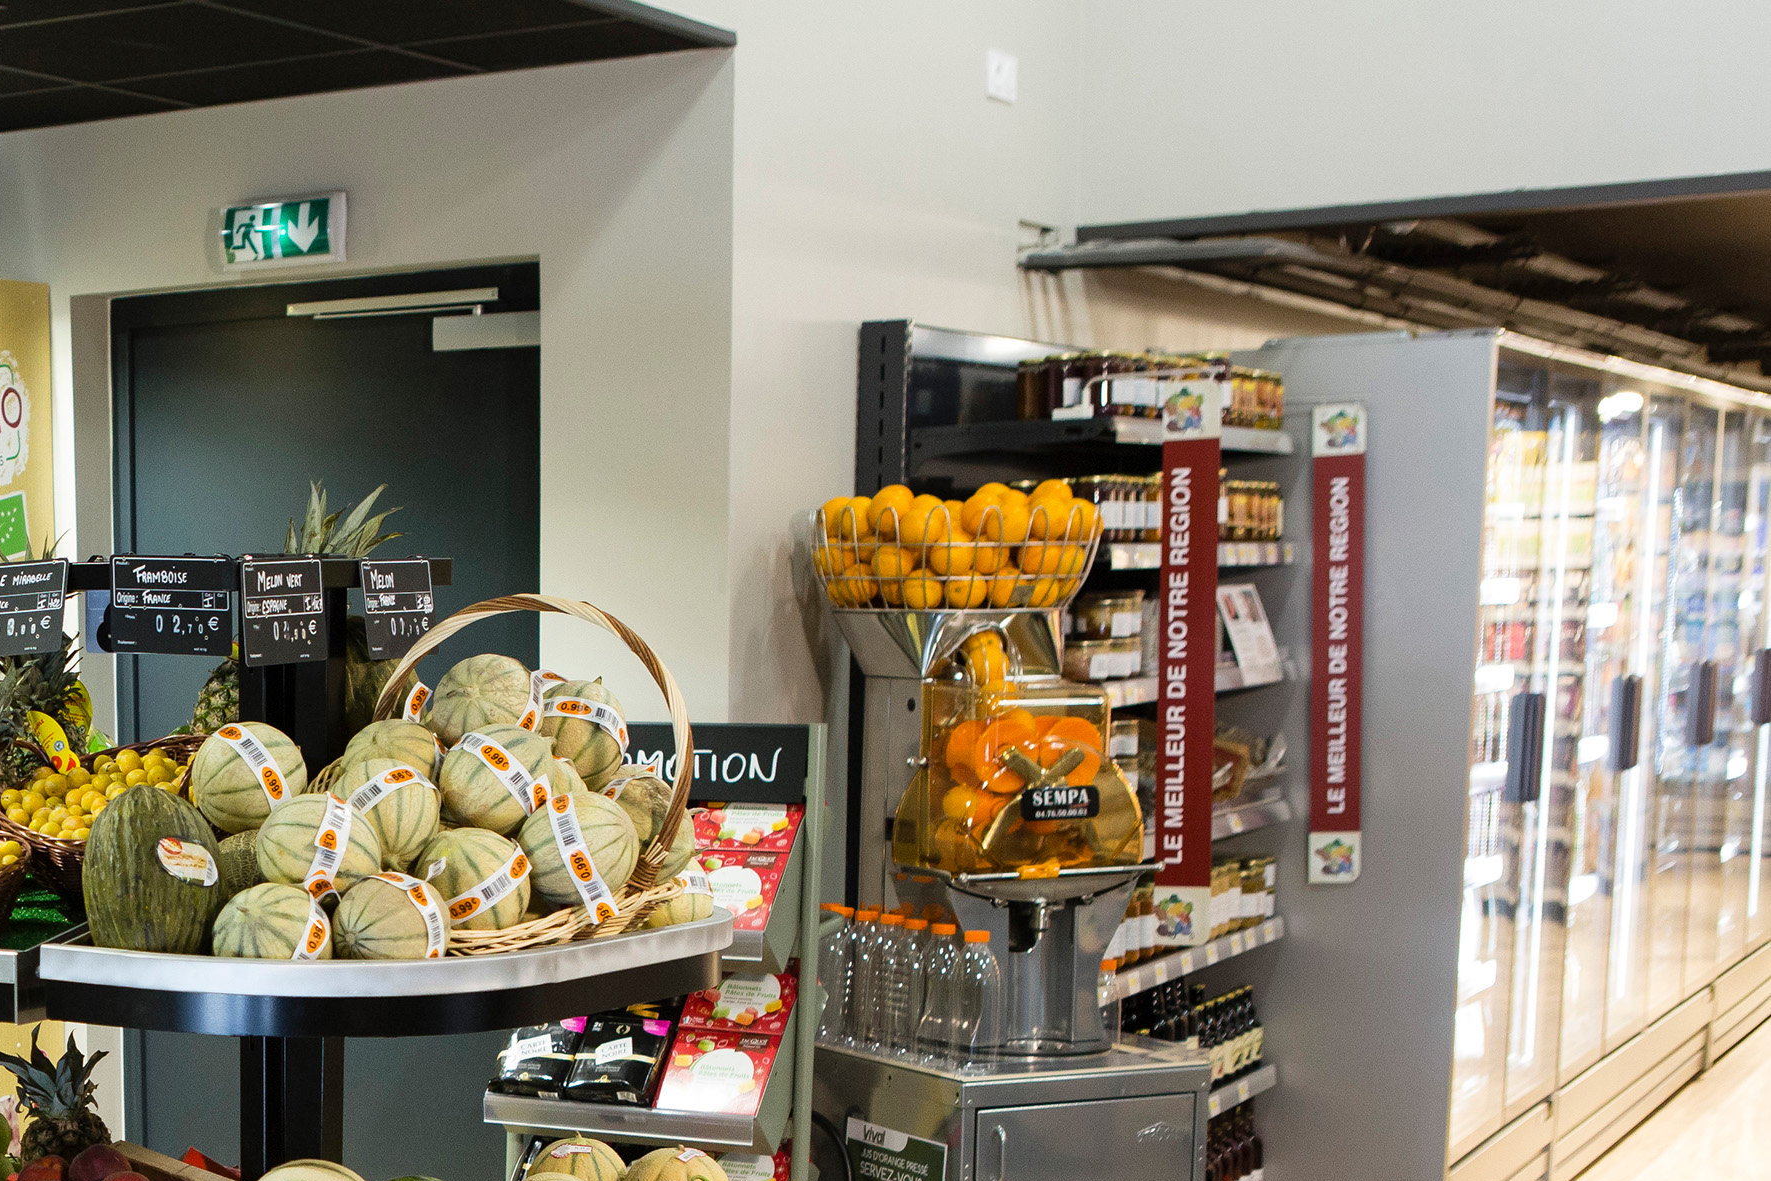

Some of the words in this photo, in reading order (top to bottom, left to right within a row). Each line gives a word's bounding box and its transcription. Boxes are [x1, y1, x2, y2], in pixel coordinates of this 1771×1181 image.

[1169, 467, 1191, 566] REGION
[1329, 477, 1350, 562] REGION
[133, 565, 188, 584] FRAMBOISE
[257, 571, 283, 593] MELON
[286, 573, 303, 588] VERT
[370, 569, 395, 590] MELON
[117, 592, 138, 605] Origine:
[142, 590, 171, 604] FRANCE
[262, 599, 287, 614] ESPAGNE
[1329, 564, 1348, 640] NOTRE
[1167, 571, 1189, 659] NOTRE
[1328, 644, 1348, 674] DE
[1166, 664, 1187, 699] DE
[1327, 678, 1348, 784] MEILLEUR
[1164, 705, 1186, 829] MEILLEUR
[1327, 787, 1345, 814] LE
[1164, 834, 1183, 864] LE
[877, 1152, 905, 1171] D'ORANGE
